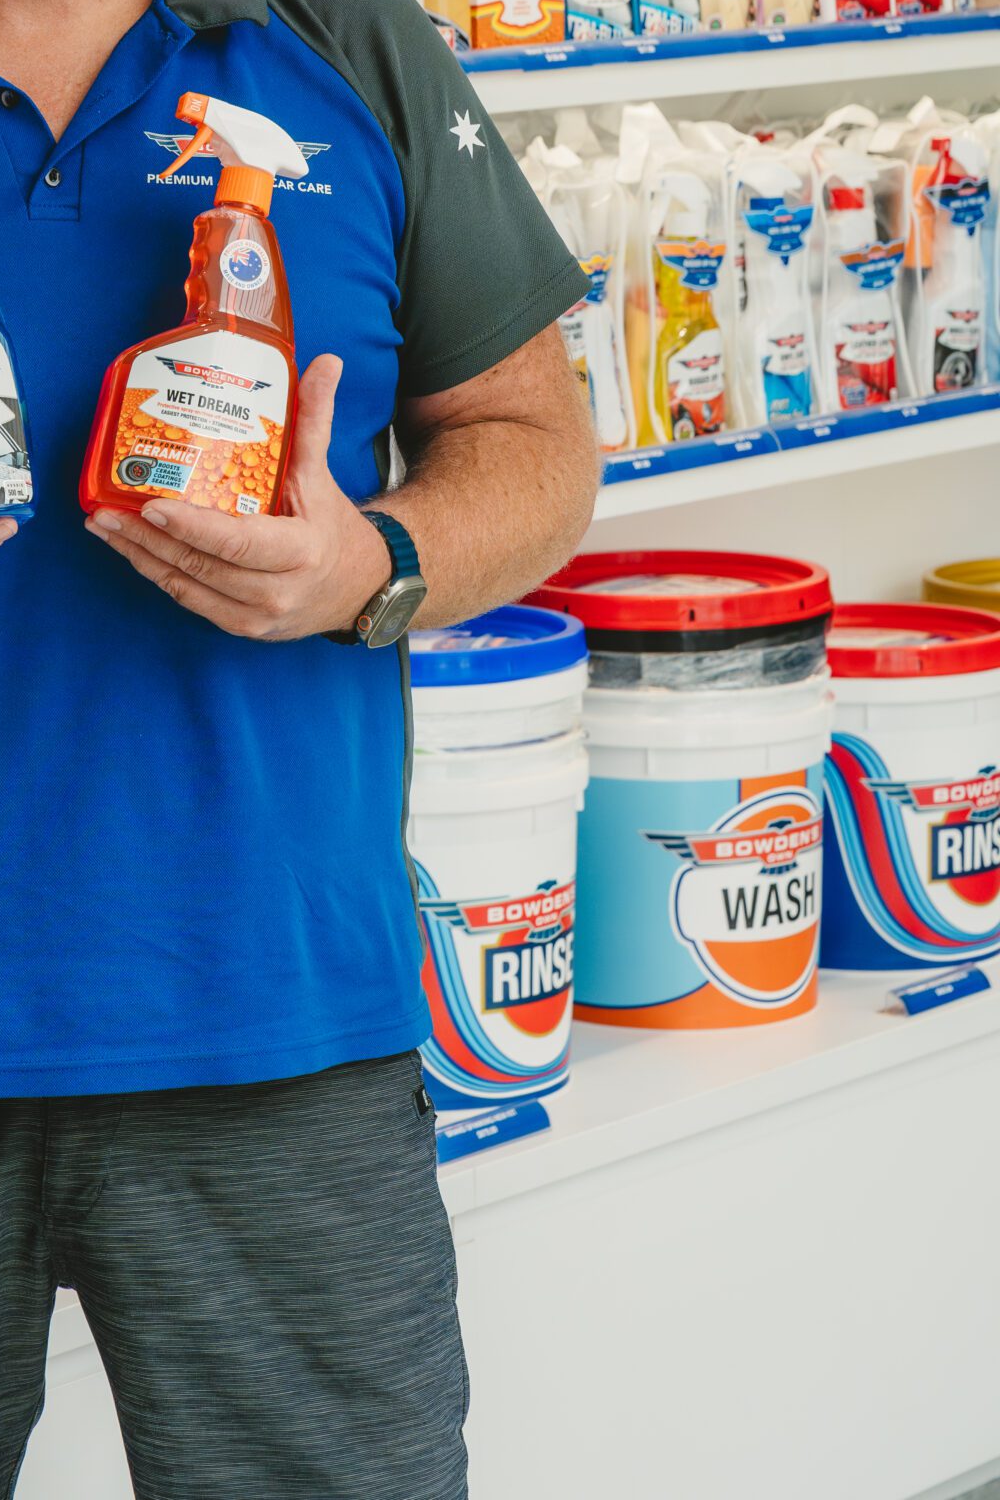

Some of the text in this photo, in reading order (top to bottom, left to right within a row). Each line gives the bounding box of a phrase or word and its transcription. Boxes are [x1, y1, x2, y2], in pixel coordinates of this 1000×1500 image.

[190, 98, 203, 113] ON
[147, 173, 332, 195] PREMIUM CAR CARE
[183, 364, 245, 386] BOWDEN'S
[167, 388, 251, 421] WET DREAMS
[160, 409, 179, 418] EASIEST
[180, 412, 208, 423] PROTECTION
[212, 419, 234, 431] STUNNING
[189, 421, 221, 434] LONG LASTING
[134, 443, 196, 464] CERAMIC
[137, 438, 197, 454] NEW FORMULA
[155, 467, 183, 477] CERAMIC
[158, 463, 180, 471] BOOSTS
[151, 477, 181, 488] SEALANTS
[153, 473, 181, 483] COATINGS
[715, 824, 819, 858] BOWDEN'S
[937, 818, 1000, 876] RINS
[722, 871, 815, 931] WASH
[492, 932, 574, 1004] RINSE
